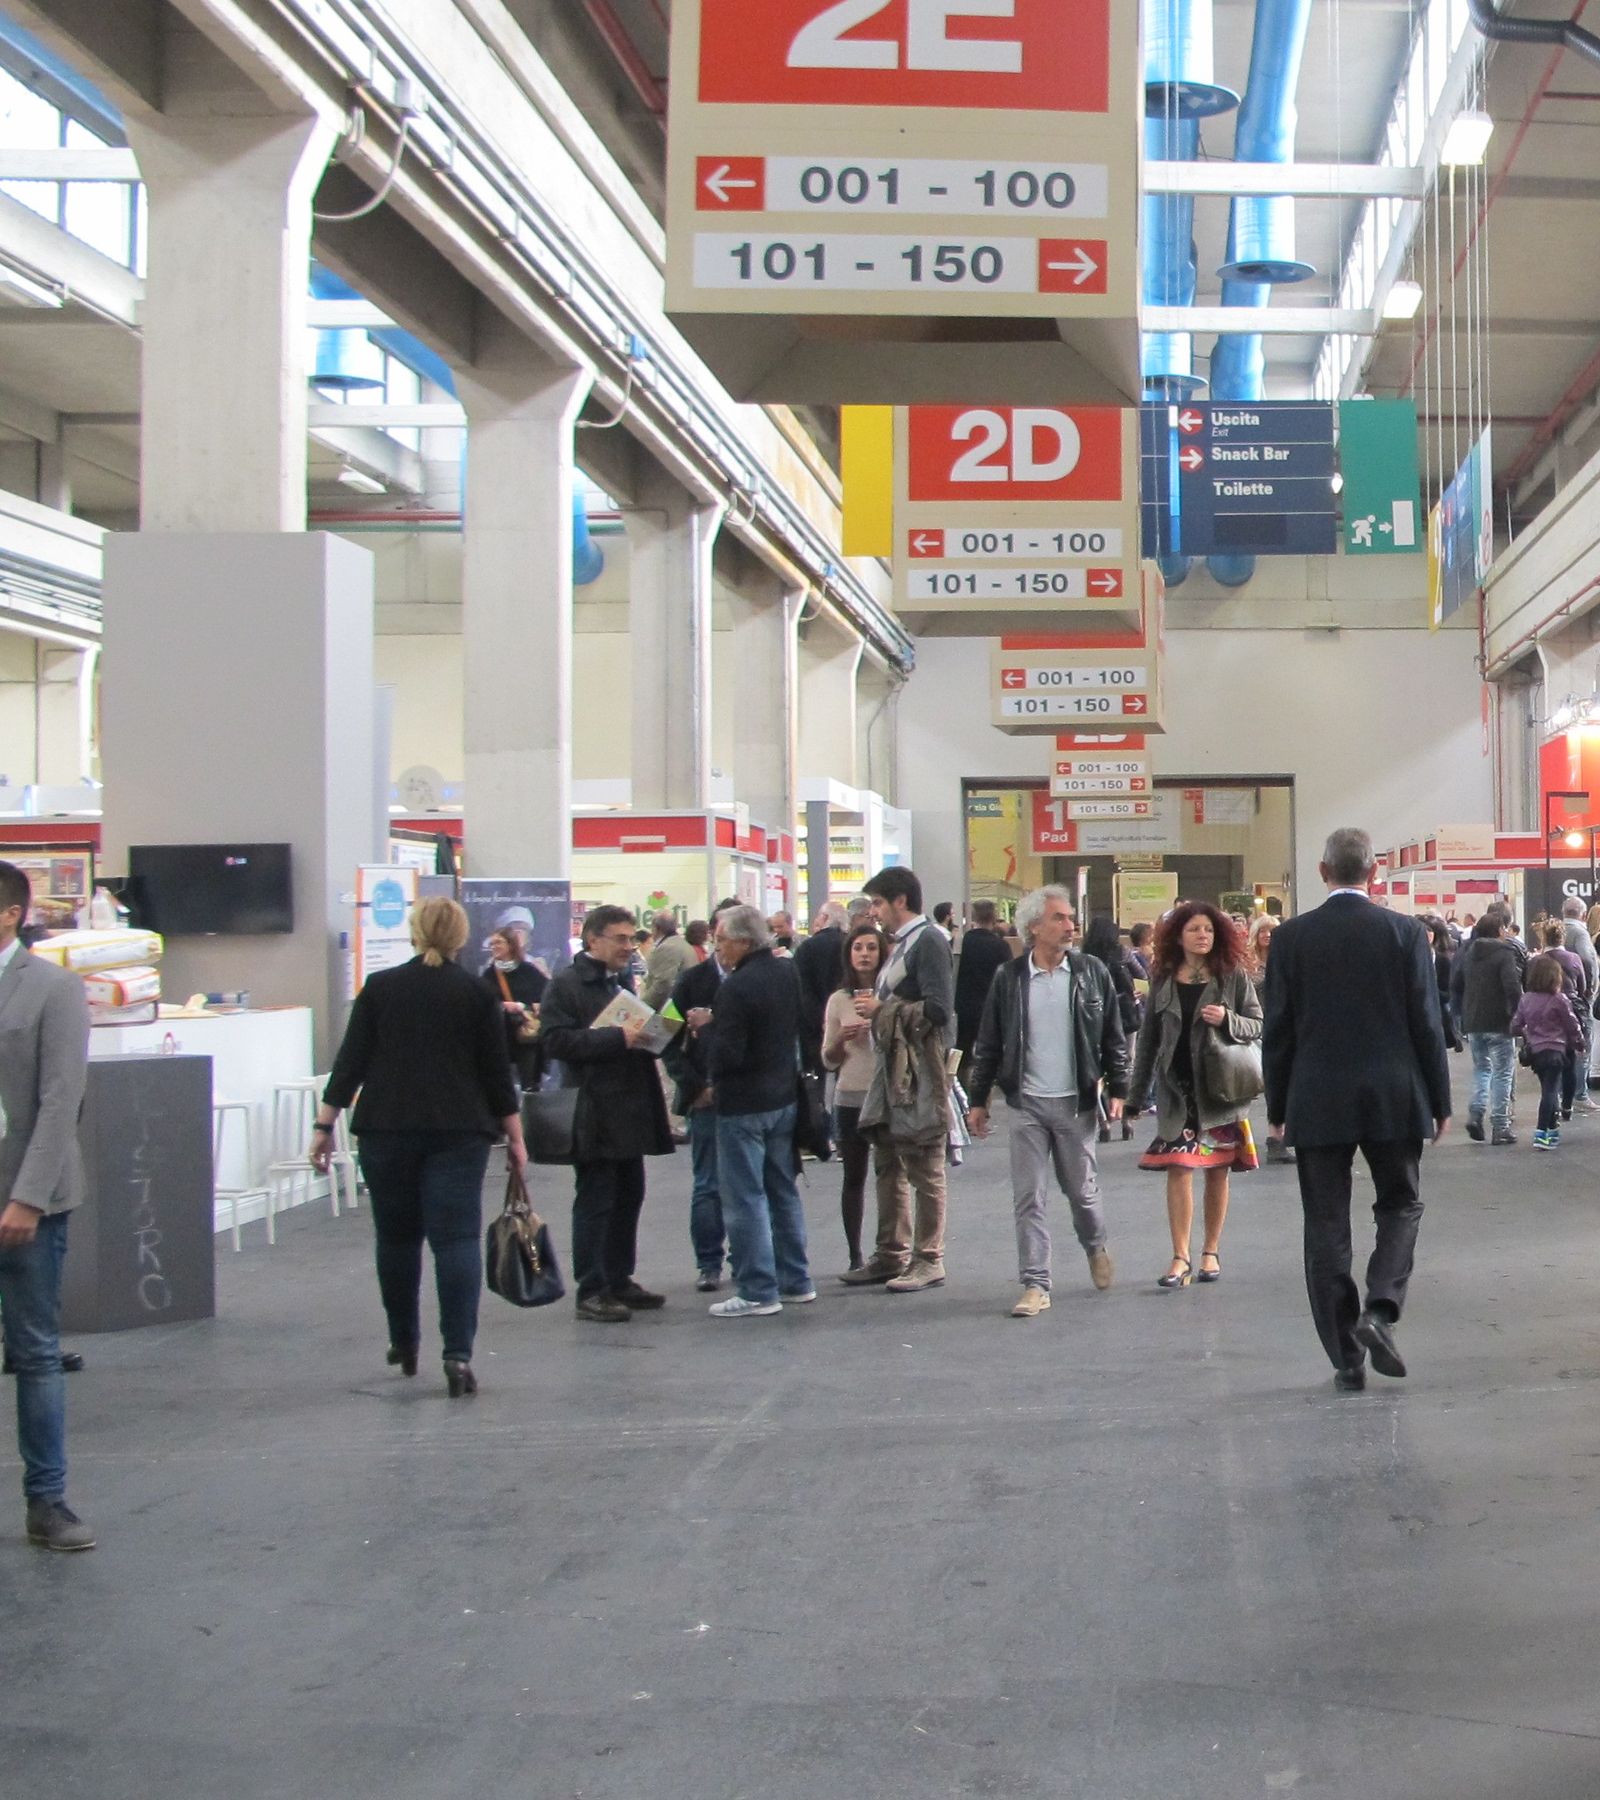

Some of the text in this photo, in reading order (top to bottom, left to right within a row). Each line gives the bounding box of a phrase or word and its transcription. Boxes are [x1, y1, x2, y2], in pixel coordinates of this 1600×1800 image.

[786, 0, 1023, 74] 2E
[799, 166, 1077, 208] 001 - 100
[730, 242, 1004, 283] 101 - 150
[1211, 411, 1260, 425] Uscita
[1211, 427, 1229, 437] Exit
[949, 408, 1081, 482] 2D
[1211, 447, 1290, 460] Snack Bar
[1213, 482, 1273, 496] Toilette
[962, 533, 1014, 553] 001
[1052, 533, 1106, 553] 100
[927, 573, 977, 594] 101
[1015, 573, 1069, 593] 150
[1038, 671, 1073, 685] 001
[1098, 670, 1135, 684] 100
[1014, 699, 1048, 713] 101
[1074, 698, 1111, 712] 150
[1077, 763, 1101, 773] 001
[1115, 763, 1139, 773] 100
[1063, 780, 1087, 790] 101
[1099, 779, 1123, 790] 150
[1079, 805, 1098, 814] 101
[1110, 804, 1129, 813] 150
[1041, 832, 1069, 843] Pad
